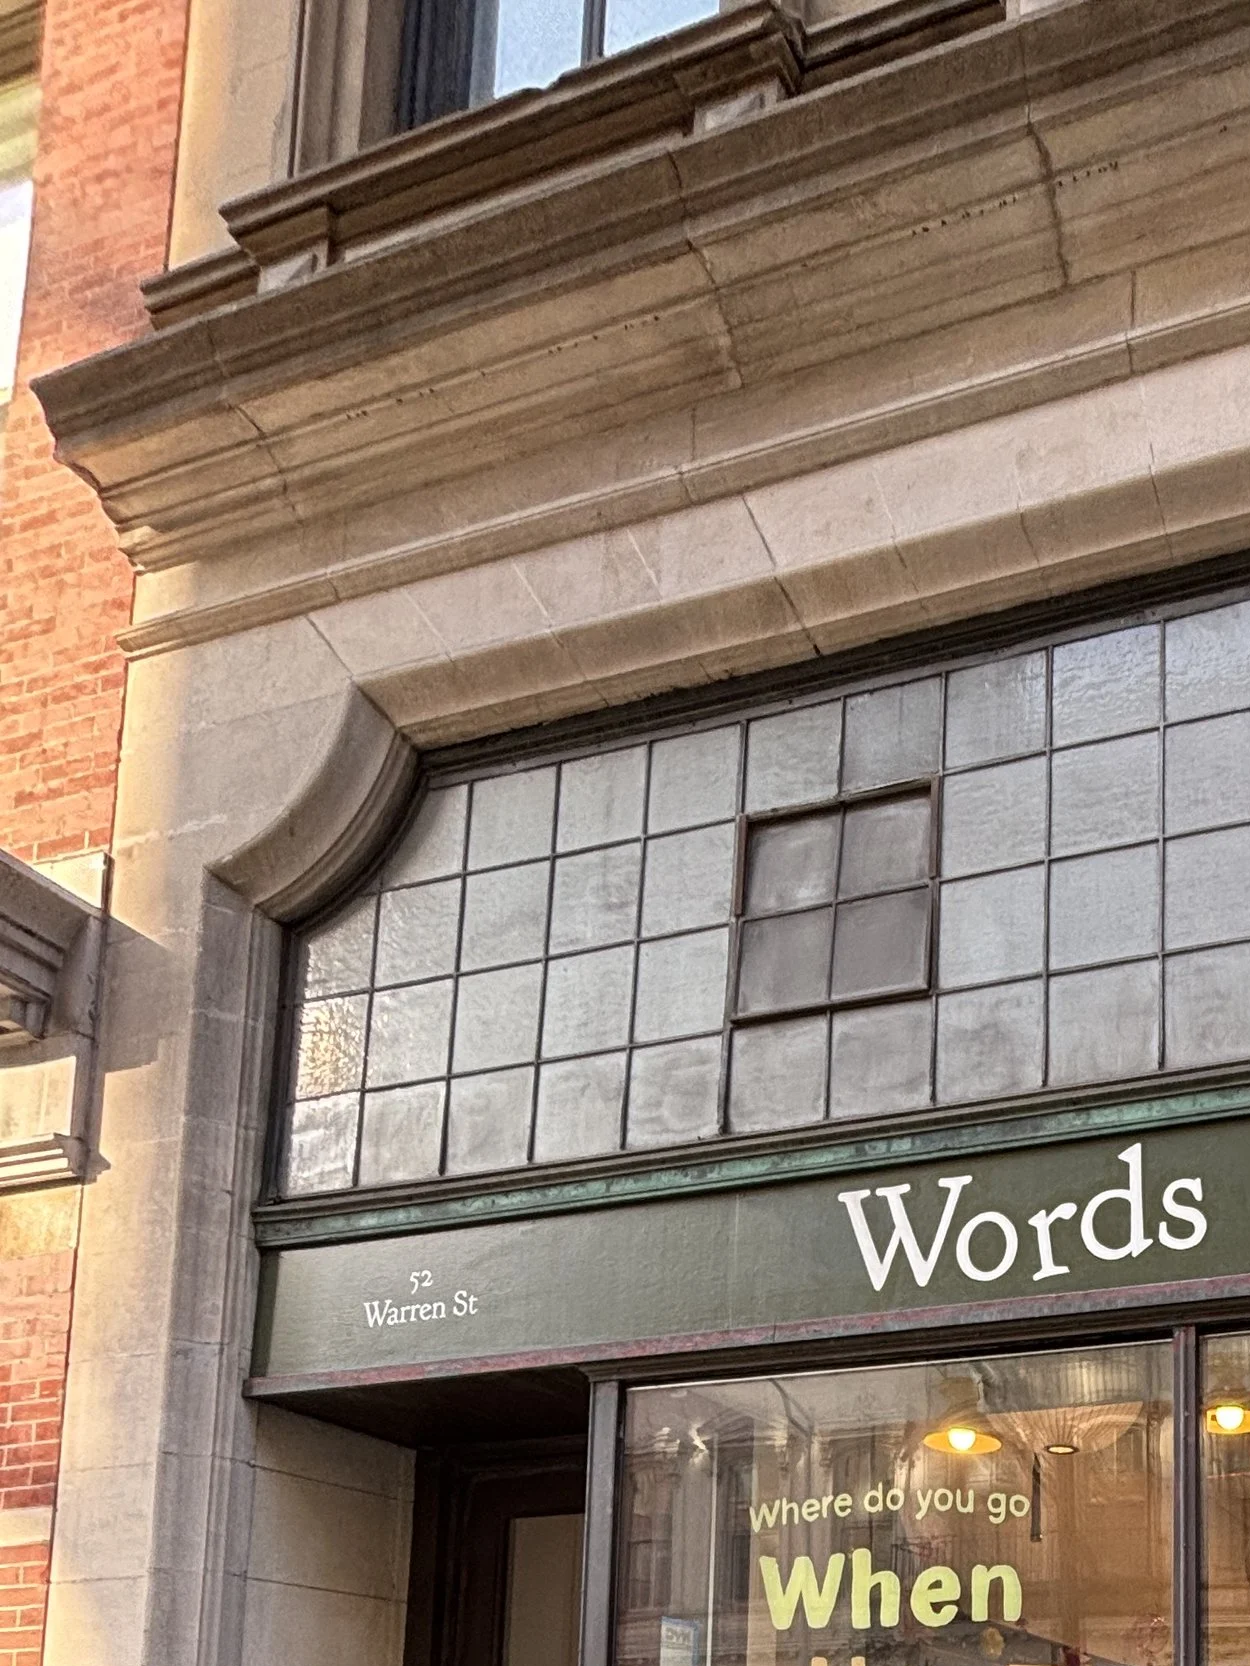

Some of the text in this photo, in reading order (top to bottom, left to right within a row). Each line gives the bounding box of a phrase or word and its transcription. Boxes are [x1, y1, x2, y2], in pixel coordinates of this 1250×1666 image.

[836, 1142, 1209, 1293] Words
[410, 1269, 434, 1295] 52
[363, 1290, 479, 1328] Warren St
[750, 1482, 1031, 1533] Where do you go
[760, 1548, 1023, 1631] When
